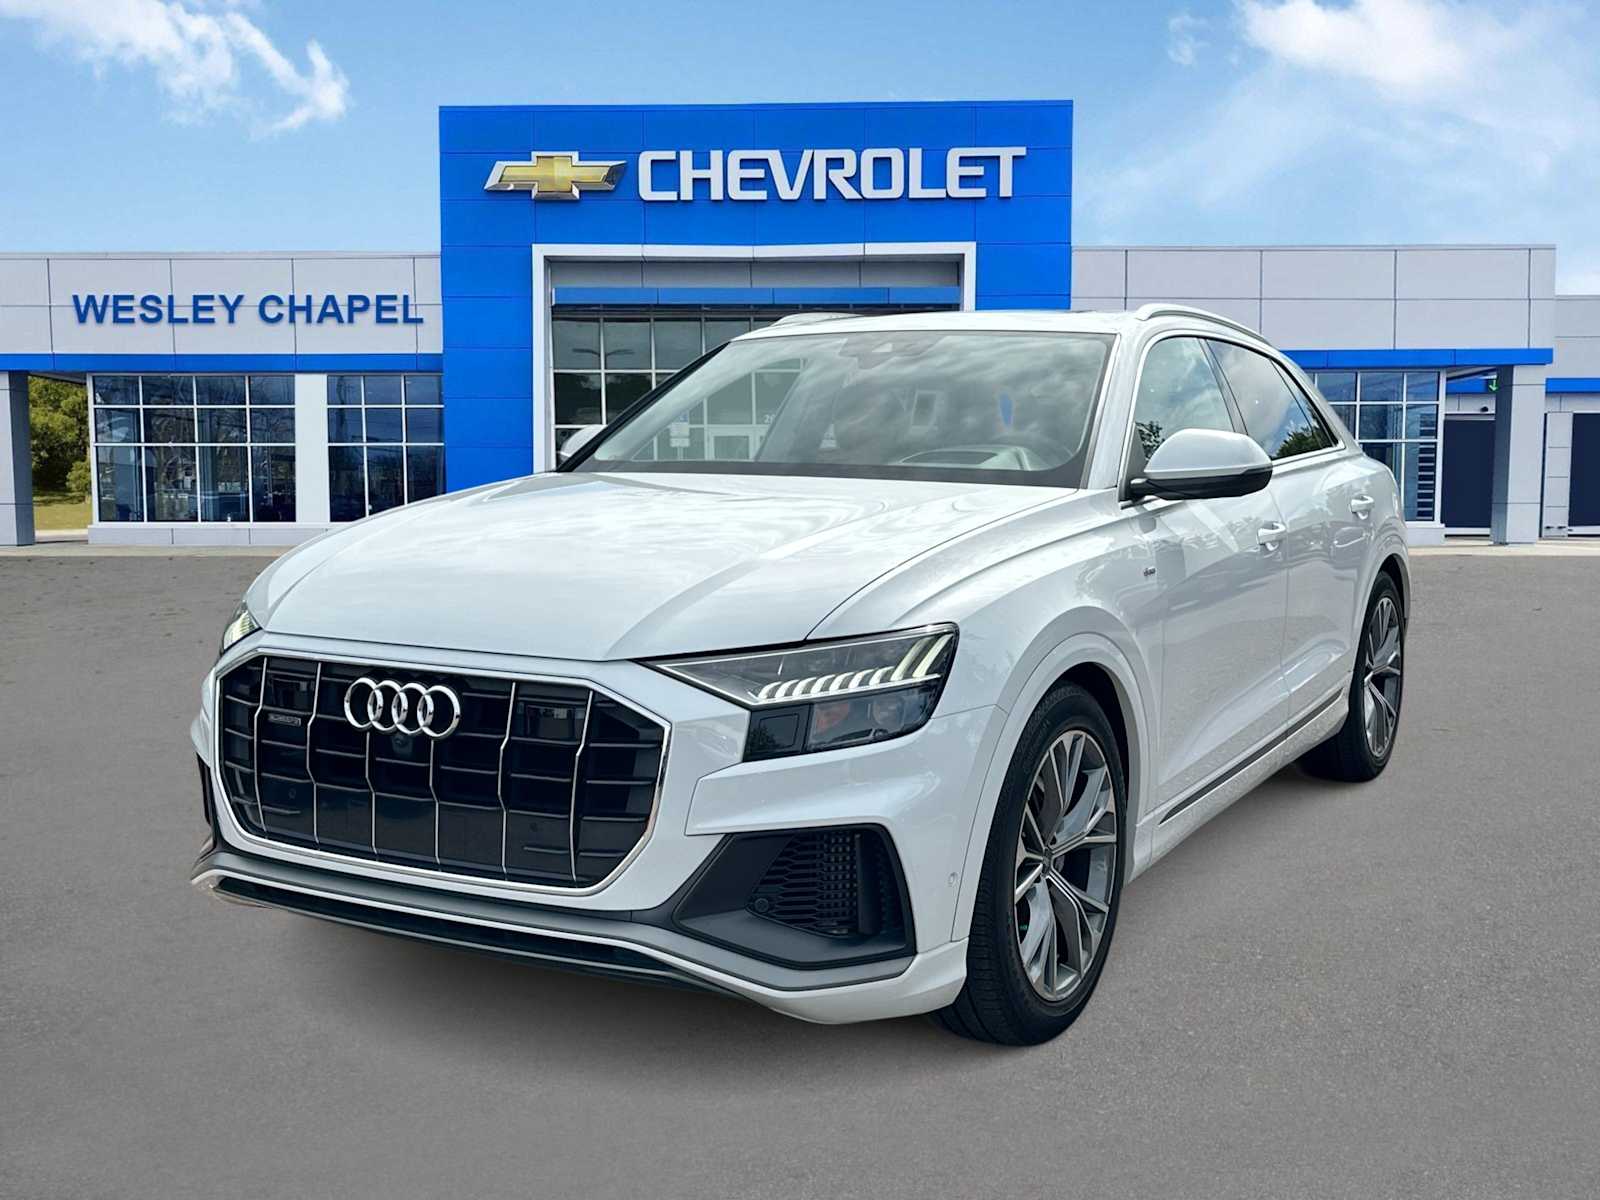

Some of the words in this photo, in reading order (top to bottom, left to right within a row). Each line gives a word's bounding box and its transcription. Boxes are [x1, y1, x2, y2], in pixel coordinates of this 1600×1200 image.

[638, 146, 1027, 201] CHEVROLET
[72, 294, 244, 324] WESLEY
[258, 294, 424, 324] CHAPEL
